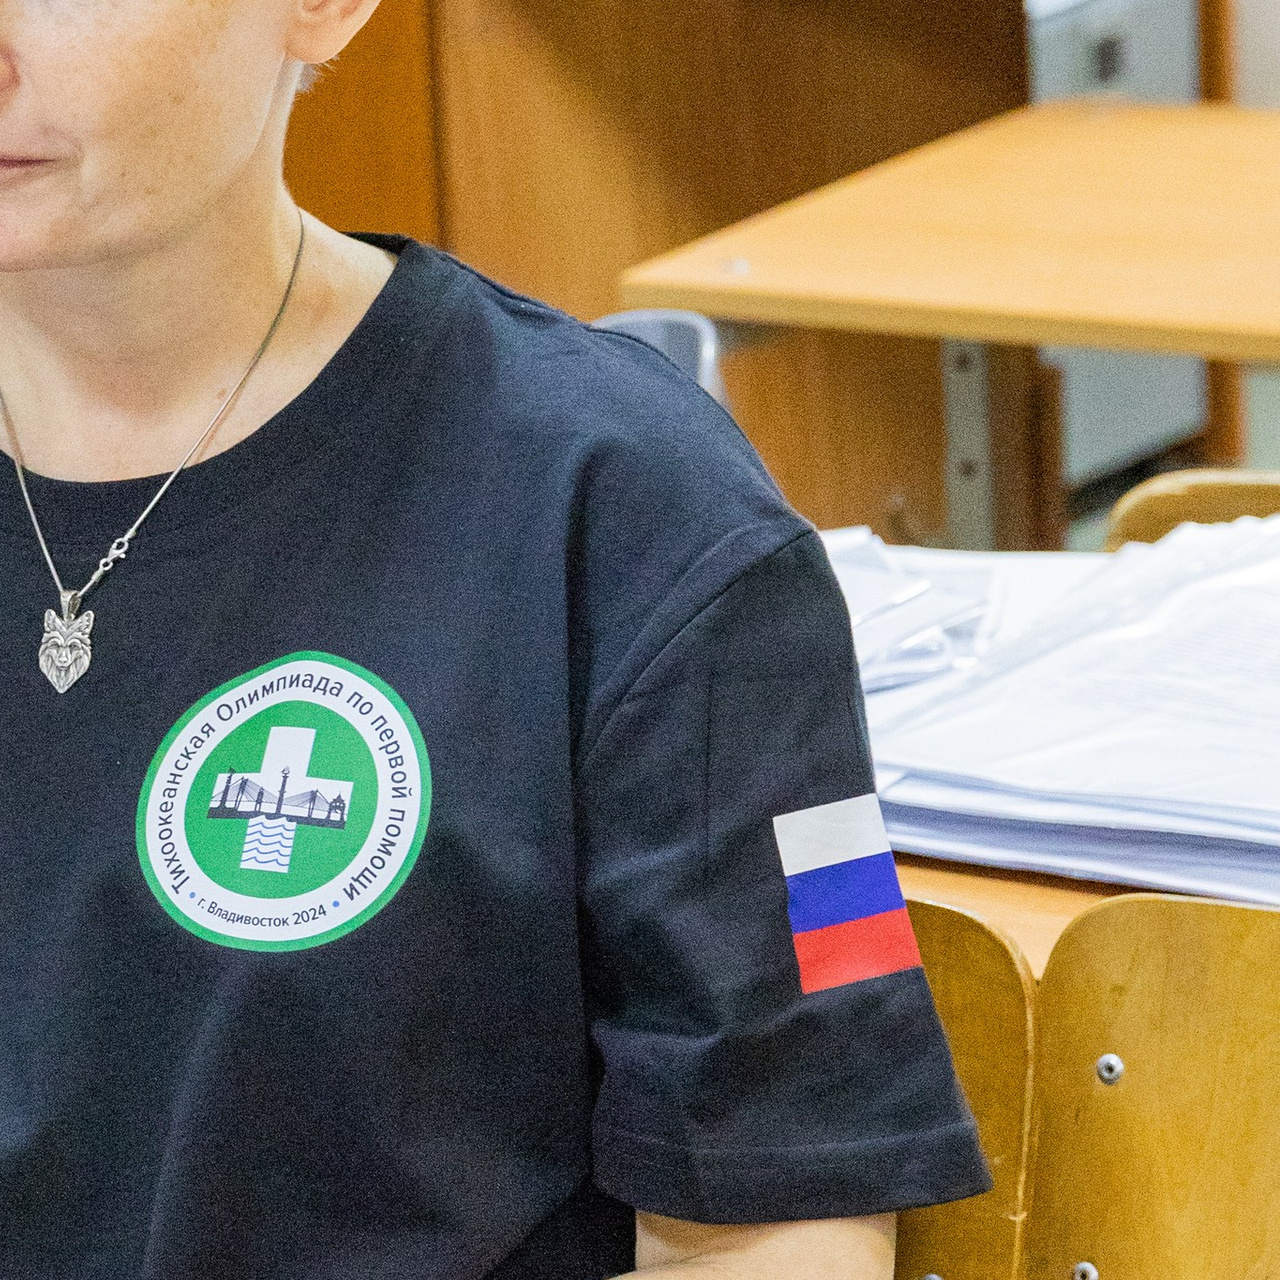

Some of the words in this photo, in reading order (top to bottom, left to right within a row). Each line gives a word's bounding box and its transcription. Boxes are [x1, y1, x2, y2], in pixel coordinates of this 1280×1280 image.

[216, 672, 344, 722] Олимпиада
[345, 691, 375, 718] по
[370, 714, 413, 801] первой
[157, 721, 217, 895] Тихоокеанская
[342, 809, 407, 902] помощи
[196, 896, 208, 910] г.
[207, 901, 290, 927] Владивосток
[292, 904, 328, 927] 2024
